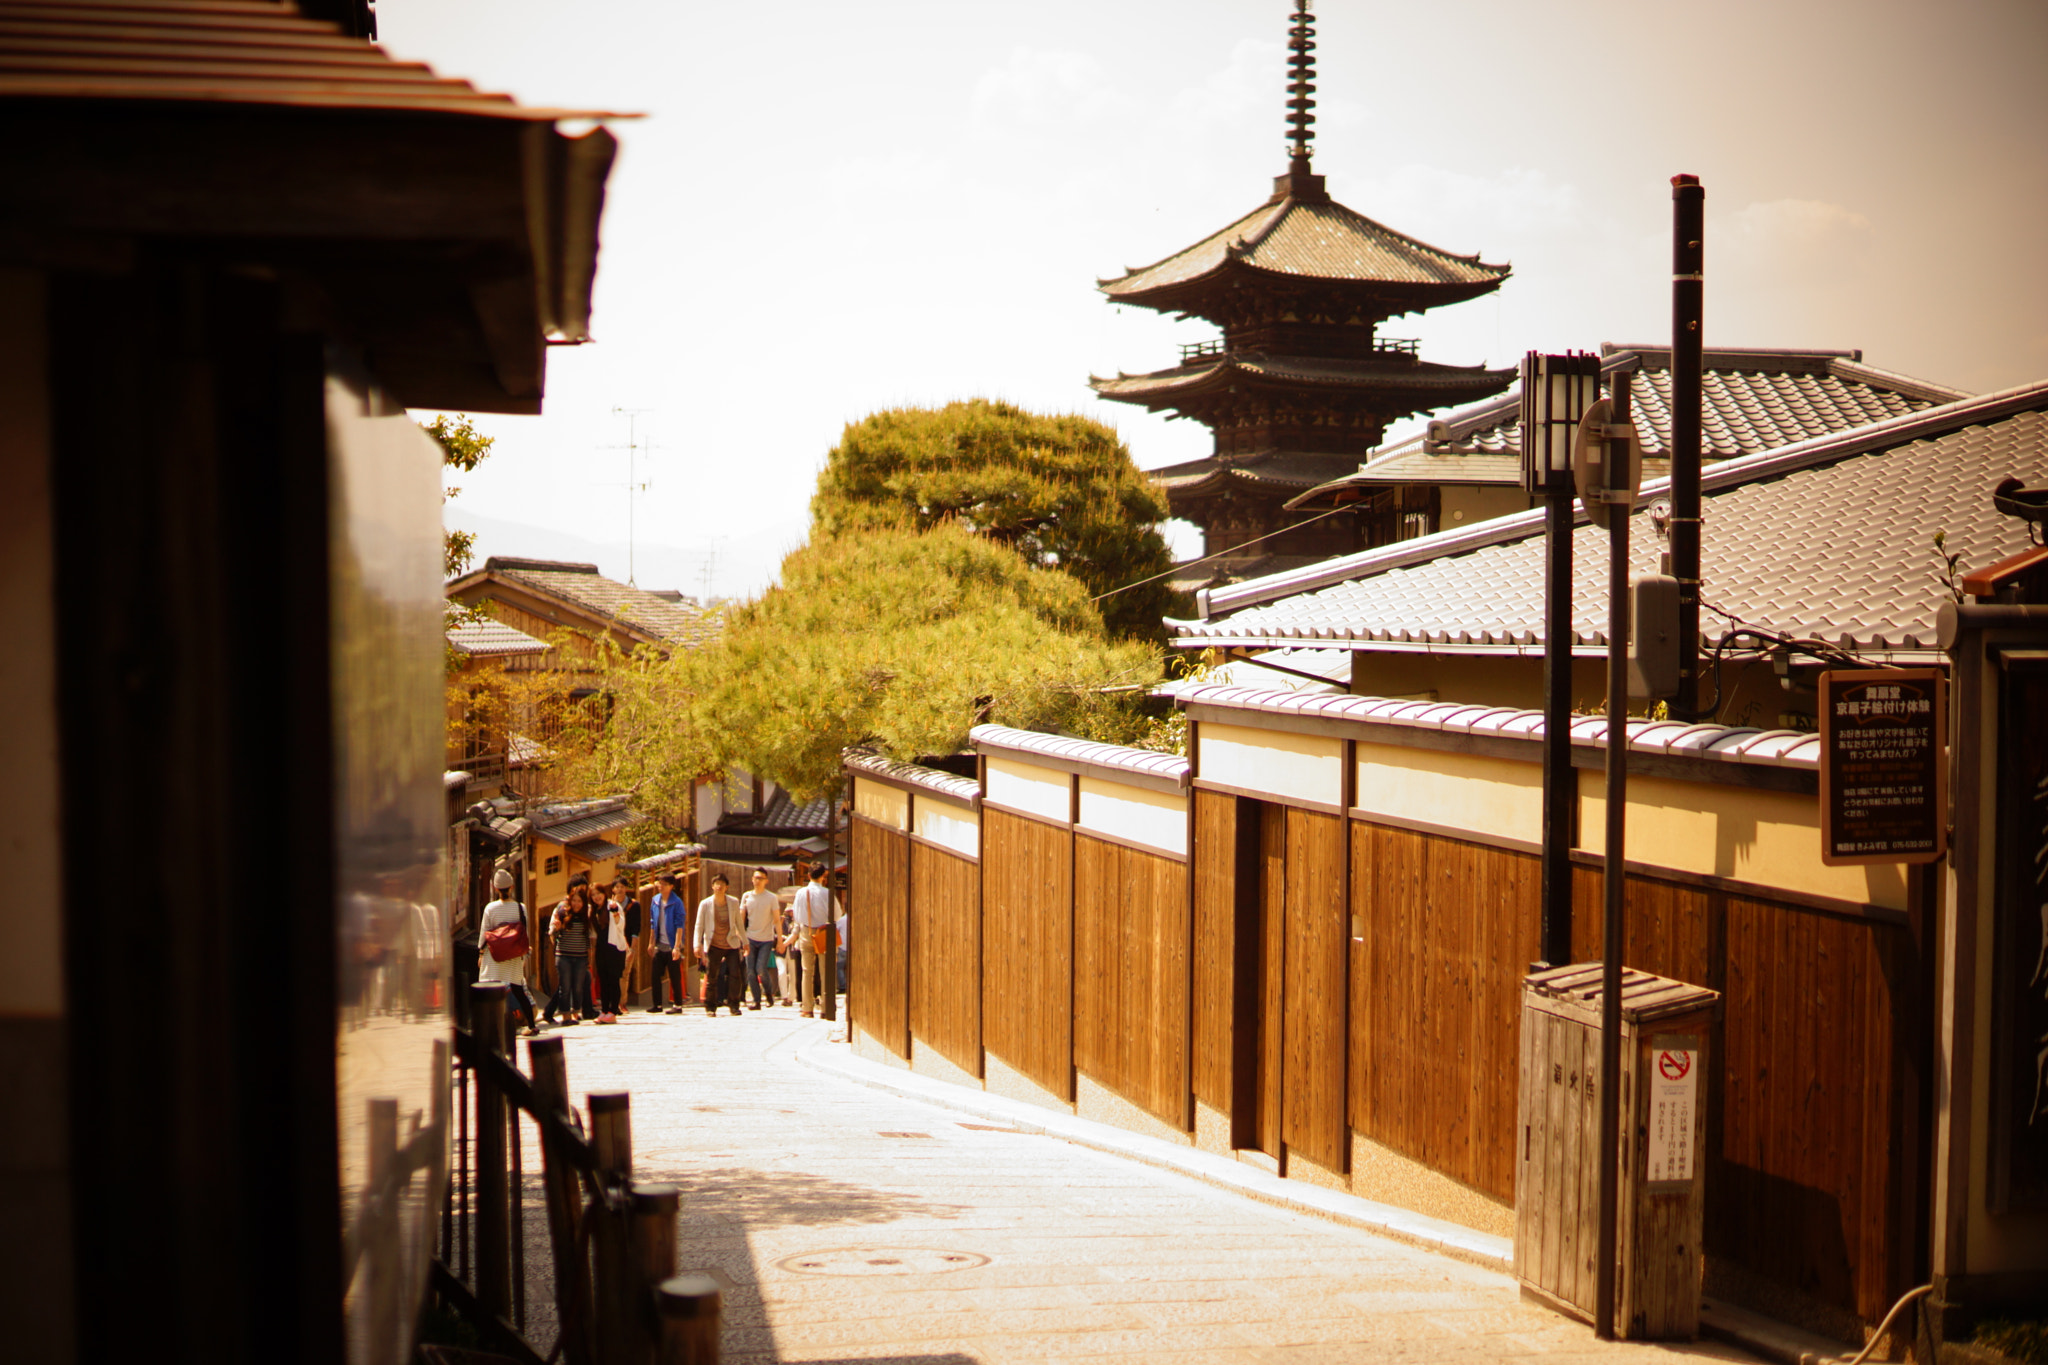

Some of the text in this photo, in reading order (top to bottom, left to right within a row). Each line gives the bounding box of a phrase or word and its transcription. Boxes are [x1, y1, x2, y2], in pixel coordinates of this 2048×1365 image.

[1865, 686, 1901, 700] 舞扇堂
[1836, 700, 1931, 716] 京扇子絵付け体験
[1839, 727, 1929, 739] お好きな絵や文字を描いて
[1839, 738, 1929, 749] あなたのオリジナル扇子を
